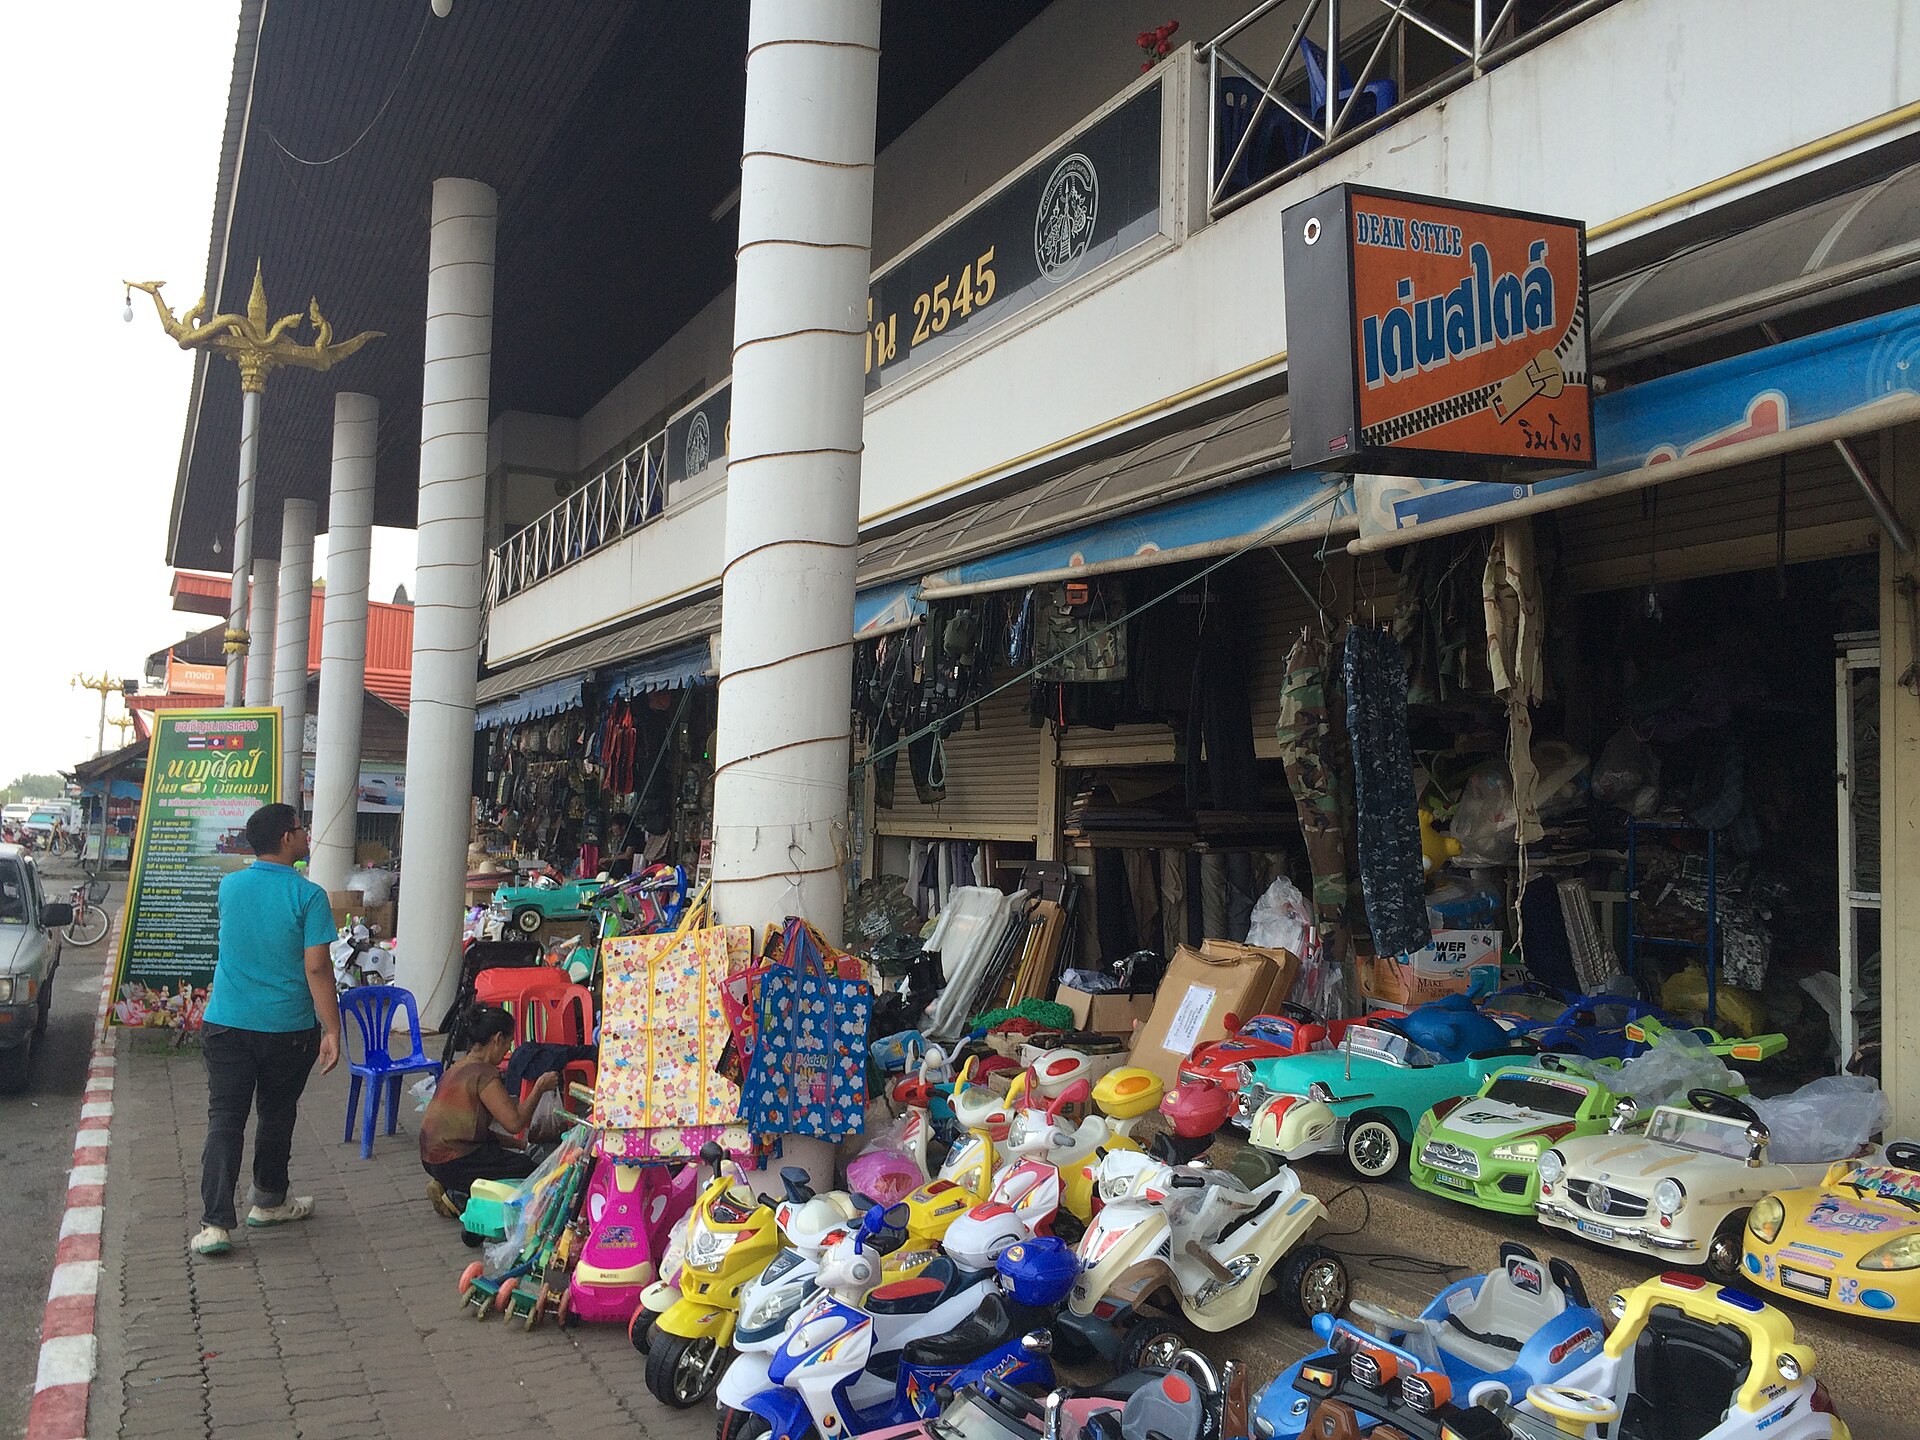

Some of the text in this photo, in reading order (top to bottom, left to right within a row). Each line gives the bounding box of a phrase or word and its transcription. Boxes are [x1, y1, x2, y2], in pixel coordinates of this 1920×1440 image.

[1356, 212, 1463, 258] DEAN STYLE
[911, 245, 996, 347] 2545
[1363, 239, 1557, 390] เด่นสไตล์
[185, 669, 215, 681] ทางเข้า
[1424, 941, 1466, 951] OWER
[1831, 1212, 1883, 1231] Girl
